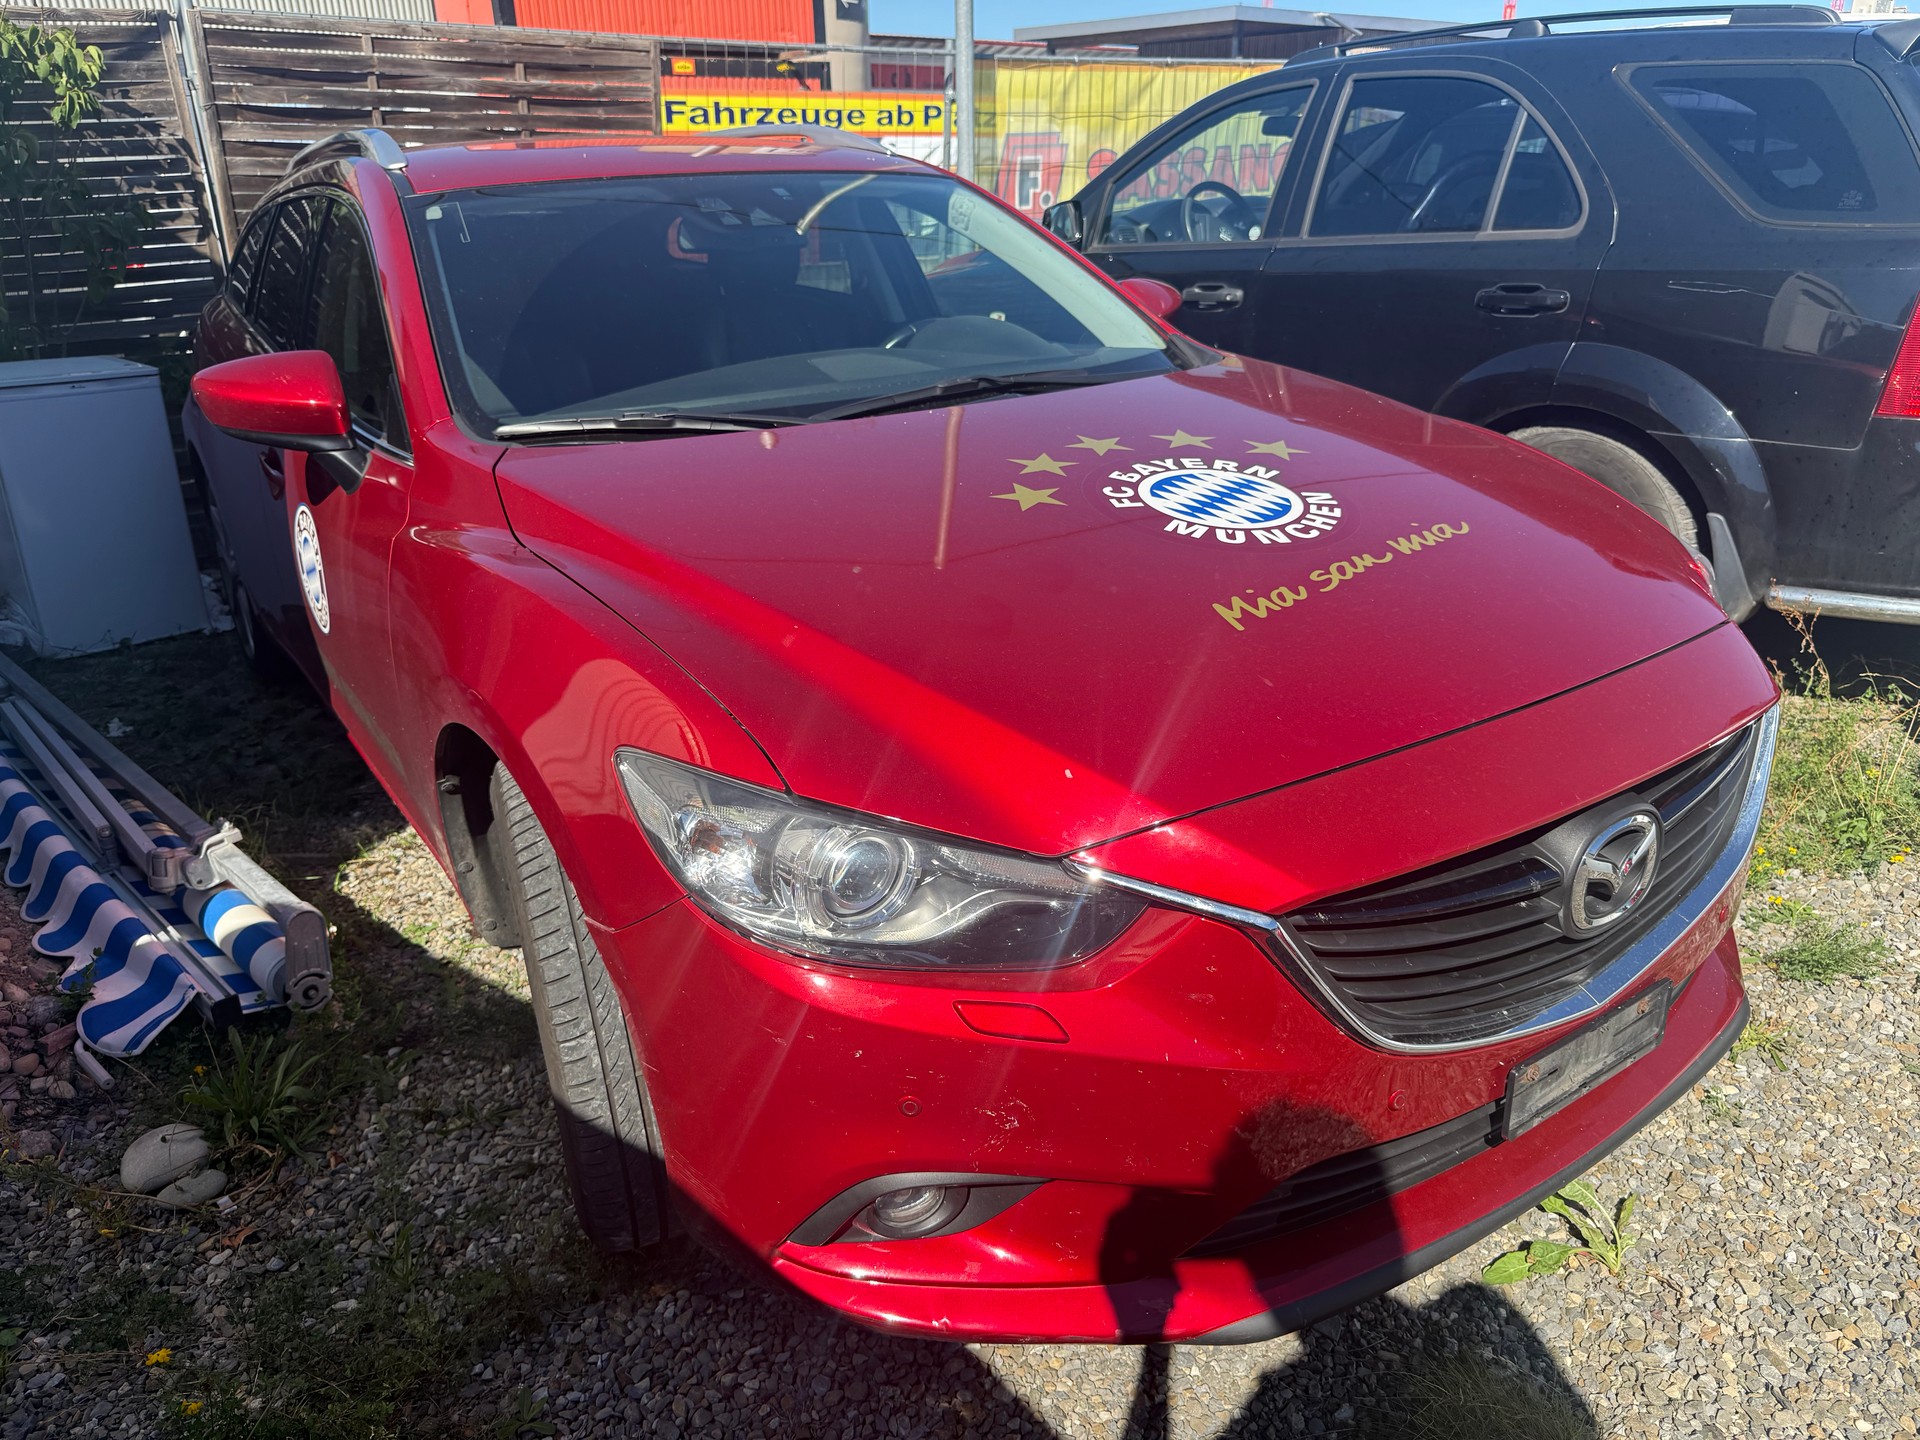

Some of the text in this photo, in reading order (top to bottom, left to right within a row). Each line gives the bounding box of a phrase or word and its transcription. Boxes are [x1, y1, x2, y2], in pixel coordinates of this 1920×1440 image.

[664, 100, 866, 128] Fahrzeuge
[876, 105, 914, 127] ab
[1102, 457, 1280, 509] FC BAYERN
[1163, 491, 1342, 545] MÜNCHEN
[1211, 521, 1470, 631] Mia san mia
